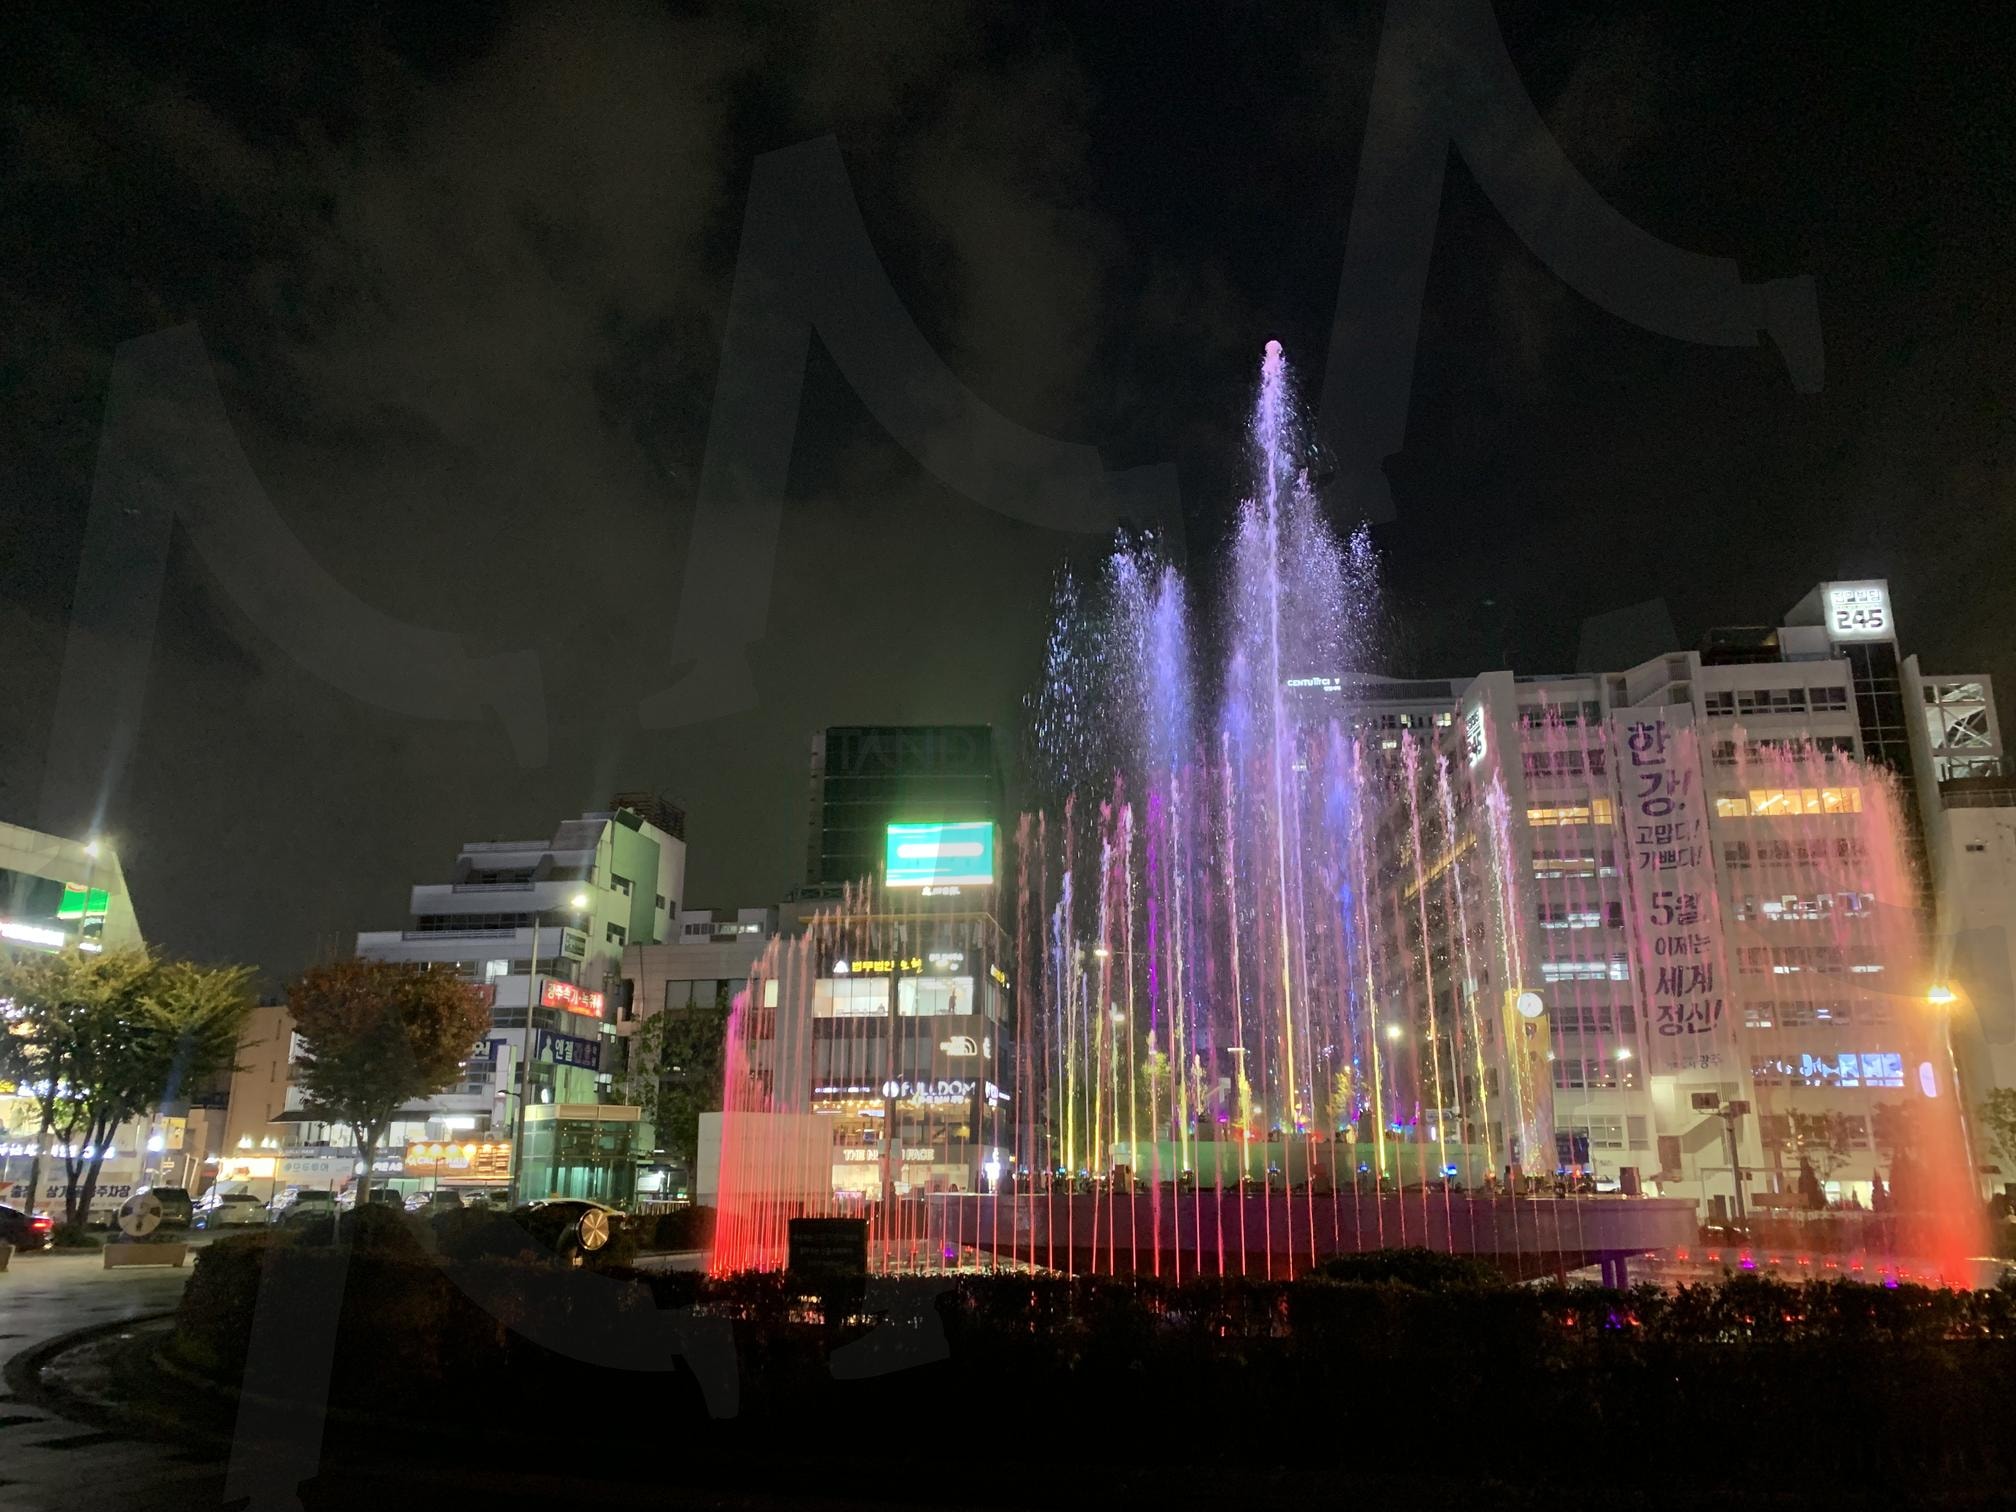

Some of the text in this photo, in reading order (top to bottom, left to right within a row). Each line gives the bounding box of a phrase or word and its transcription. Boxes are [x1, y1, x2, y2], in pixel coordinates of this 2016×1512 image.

[1836, 609, 1883, 629] 245
[1628, 720, 1671, 766] 한
[1637, 768, 1692, 817] 강!
[1635, 819, 1700, 845] 고맙다!
[1639, 847, 1702, 870] 기쁘다!
[1650, 891, 1700, 926] 5월
[1655, 933, 1711, 957] 이제는
[851, 960, 894, 972] 법무법인
[1655, 963, 1713, 997] 세계
[1656, 1000, 1722, 1036] 정신!
[843, 1149, 866, 1161] THE
[906, 1149, 934, 1161] FACE
